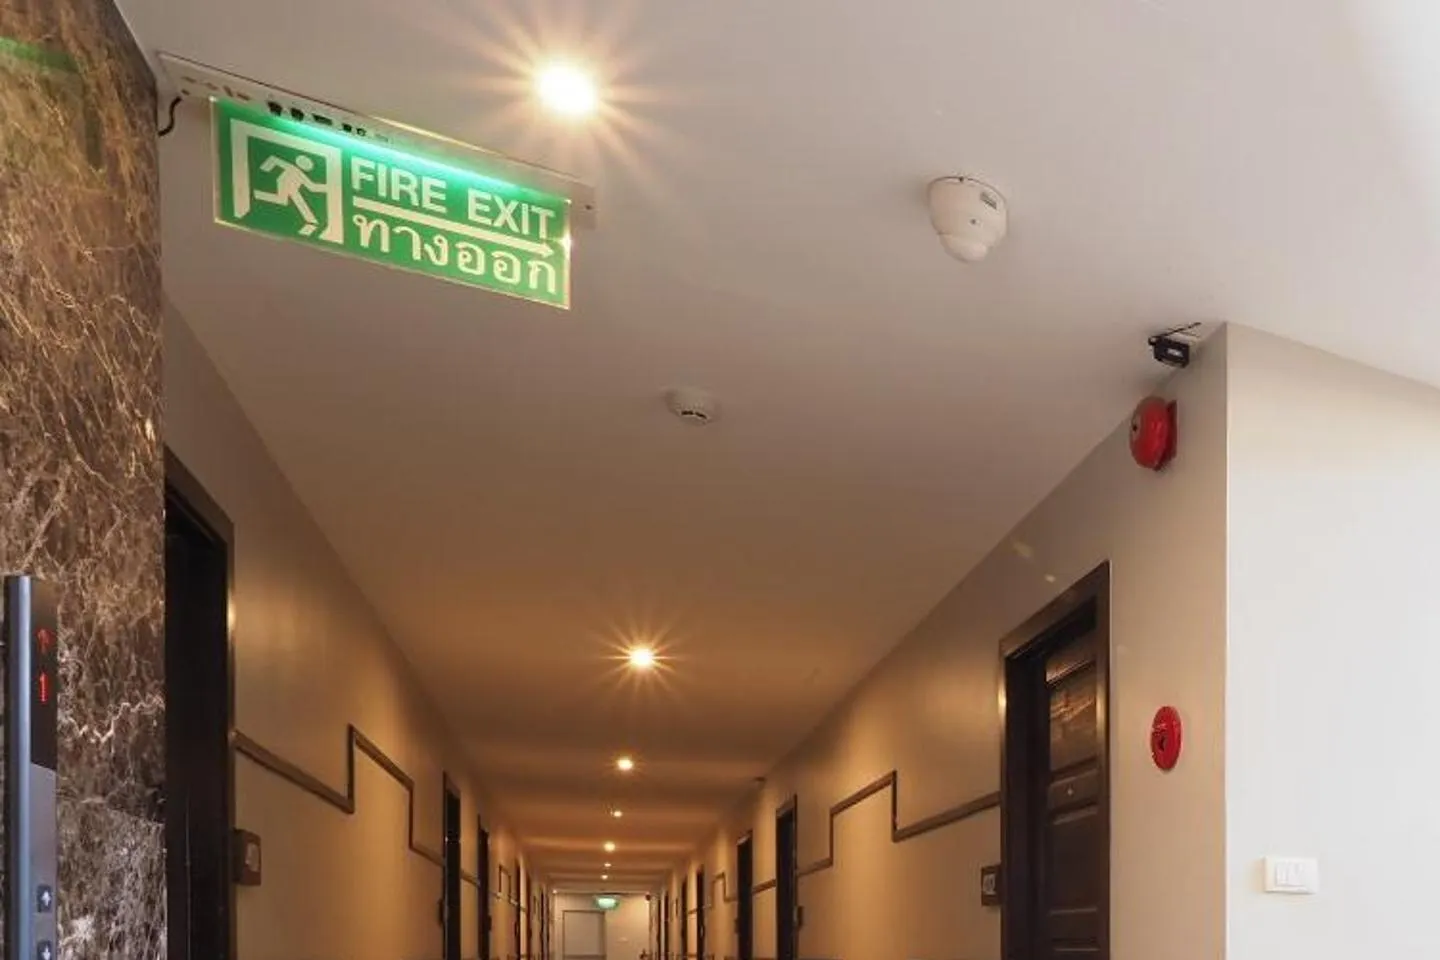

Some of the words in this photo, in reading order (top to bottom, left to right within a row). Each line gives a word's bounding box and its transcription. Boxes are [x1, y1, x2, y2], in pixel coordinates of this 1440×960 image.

[351, 155, 448, 213] FIRE
[467, 187, 555, 240] EXIT
[353, 213, 556, 294] ทางออก
